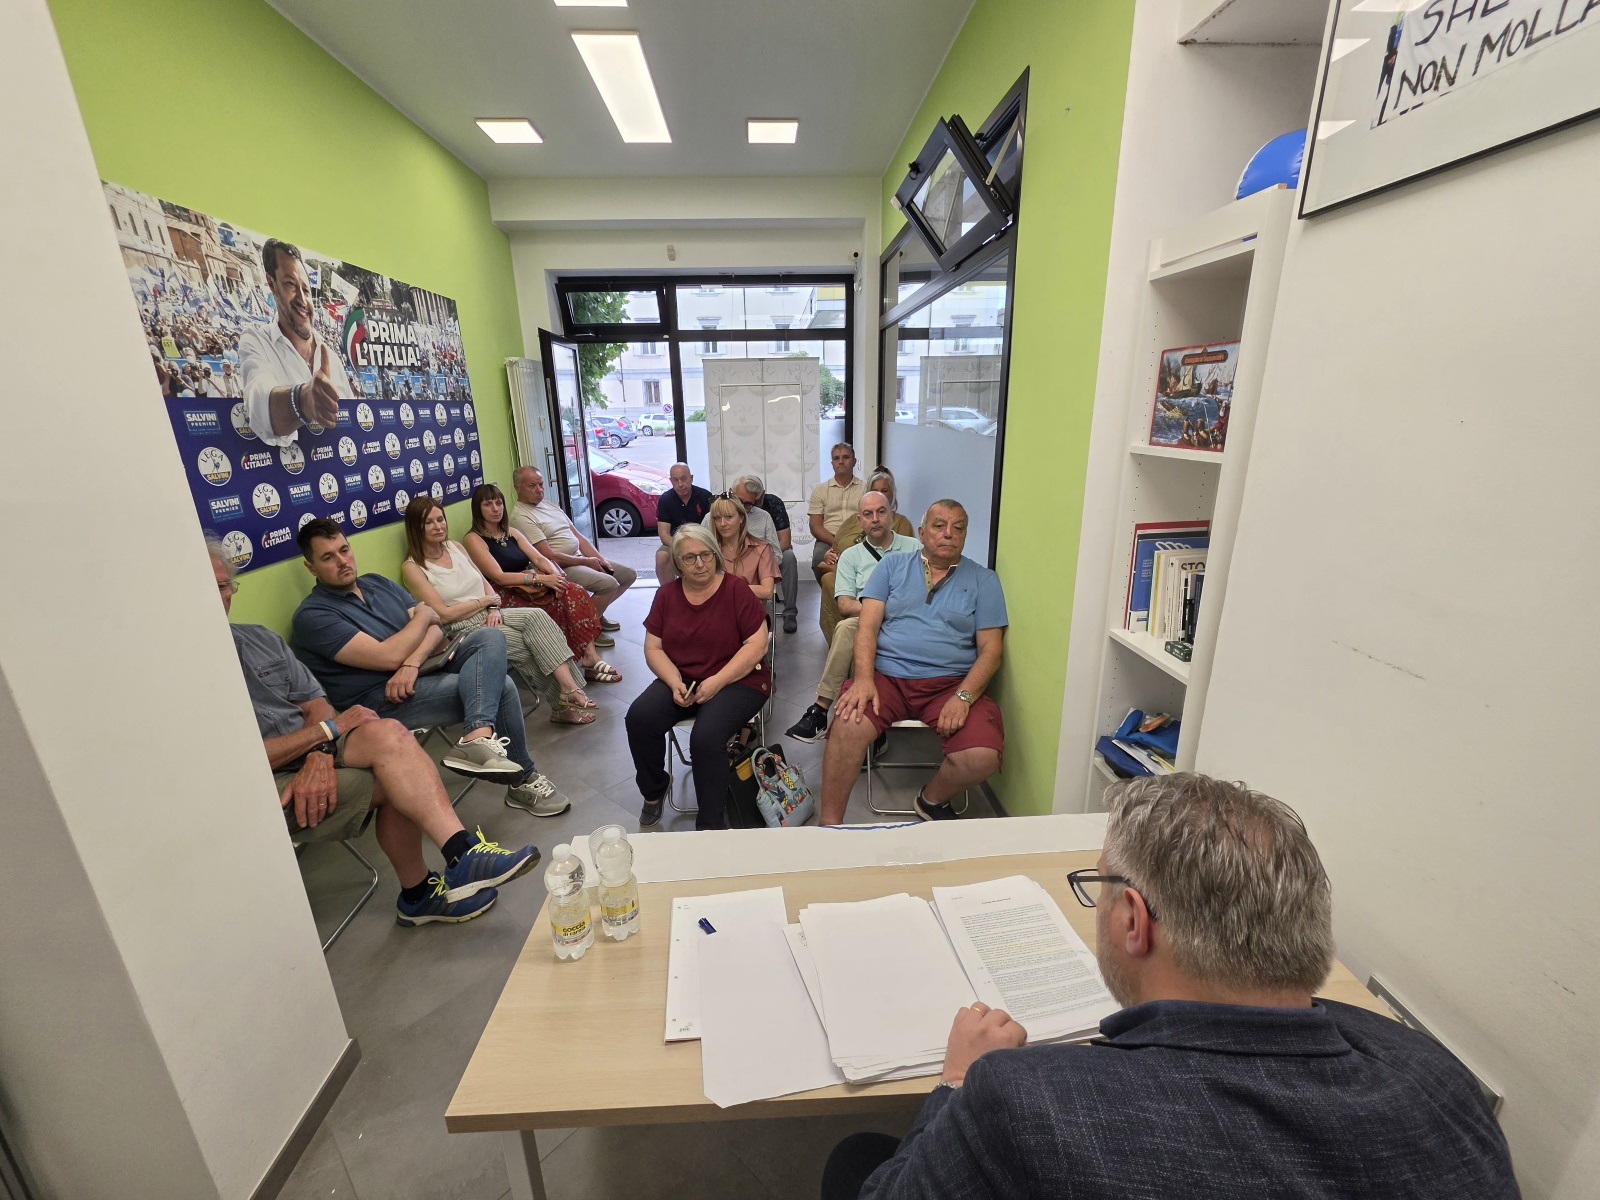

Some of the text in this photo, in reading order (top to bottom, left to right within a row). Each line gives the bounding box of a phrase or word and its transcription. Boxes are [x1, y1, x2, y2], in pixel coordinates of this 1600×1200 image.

[1393, 43, 1467, 110] NON
[368, 320, 418, 344] PRIMA
[356, 342, 420, 366] L'ITALIA!
[186, 413, 217, 422] SALVINI
[200, 450, 224, 464] LEGA
[250, 452, 271, 461] PRIMA
[206, 472, 230, 480] SALVINI
[254, 486, 274, 498] LEGA
[290, 485, 311, 494] SALVINI
[210, 498, 240, 510] SALVINI
[260, 505, 279, 514] SALVINI
[270, 527, 291, 539] PRIMA
[224, 534, 246, 547] LEGA
